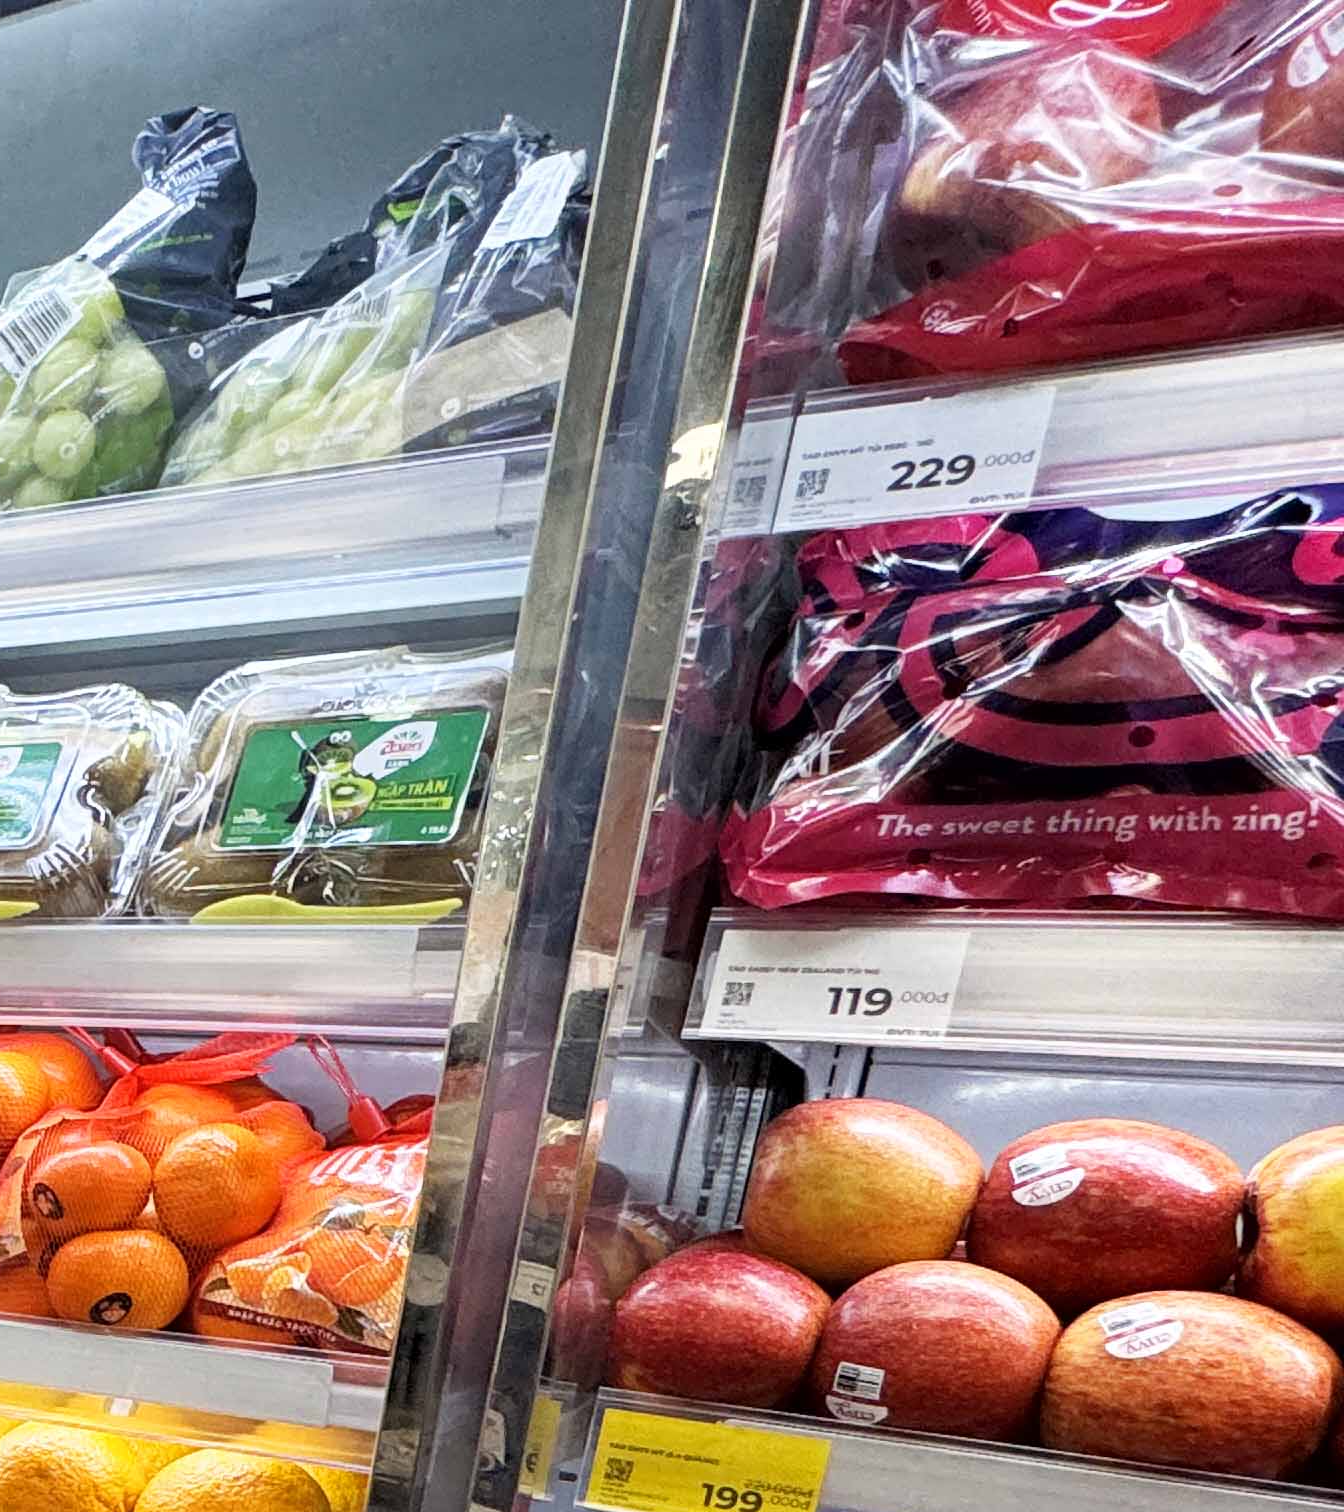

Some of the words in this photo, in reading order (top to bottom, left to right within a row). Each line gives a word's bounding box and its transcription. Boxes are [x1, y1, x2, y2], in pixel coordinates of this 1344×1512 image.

[886, 454, 976, 492] 229
[875, 813, 933, 837] The
[942, 813, 1035, 836] sweet
[1046, 807, 1136, 843] thing
[1148, 806, 1222, 834] with
[1231, 803, 1319, 843] zing!
[827, 987, 893, 1016] 119
